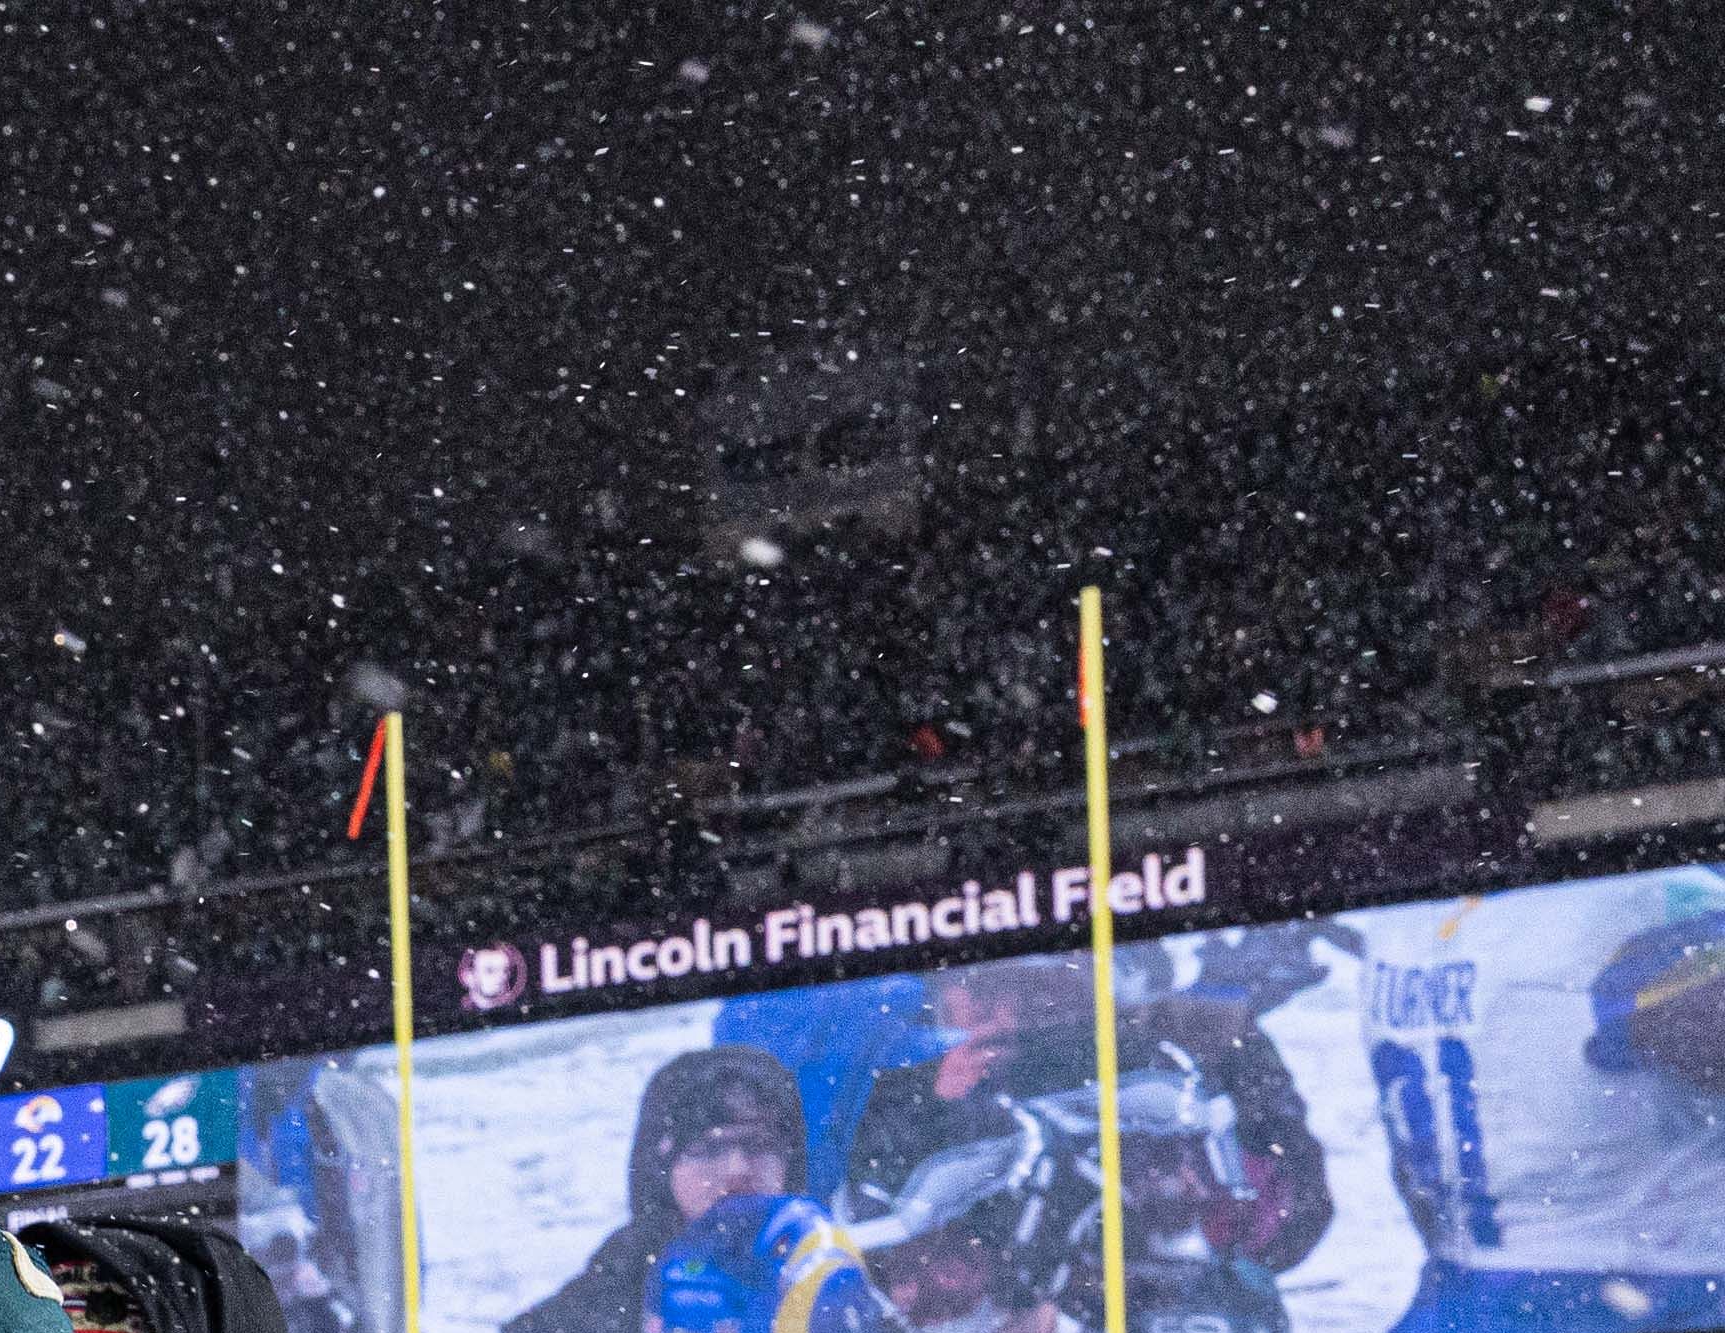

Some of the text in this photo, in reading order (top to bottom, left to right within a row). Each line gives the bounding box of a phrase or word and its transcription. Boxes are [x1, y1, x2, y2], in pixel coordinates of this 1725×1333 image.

[540, 918, 750, 994] Lincoln
[765, 871, 1042, 965] Financial
[10, 1133, 68, 1185] 22
[141, 1115, 201, 1169] 28
